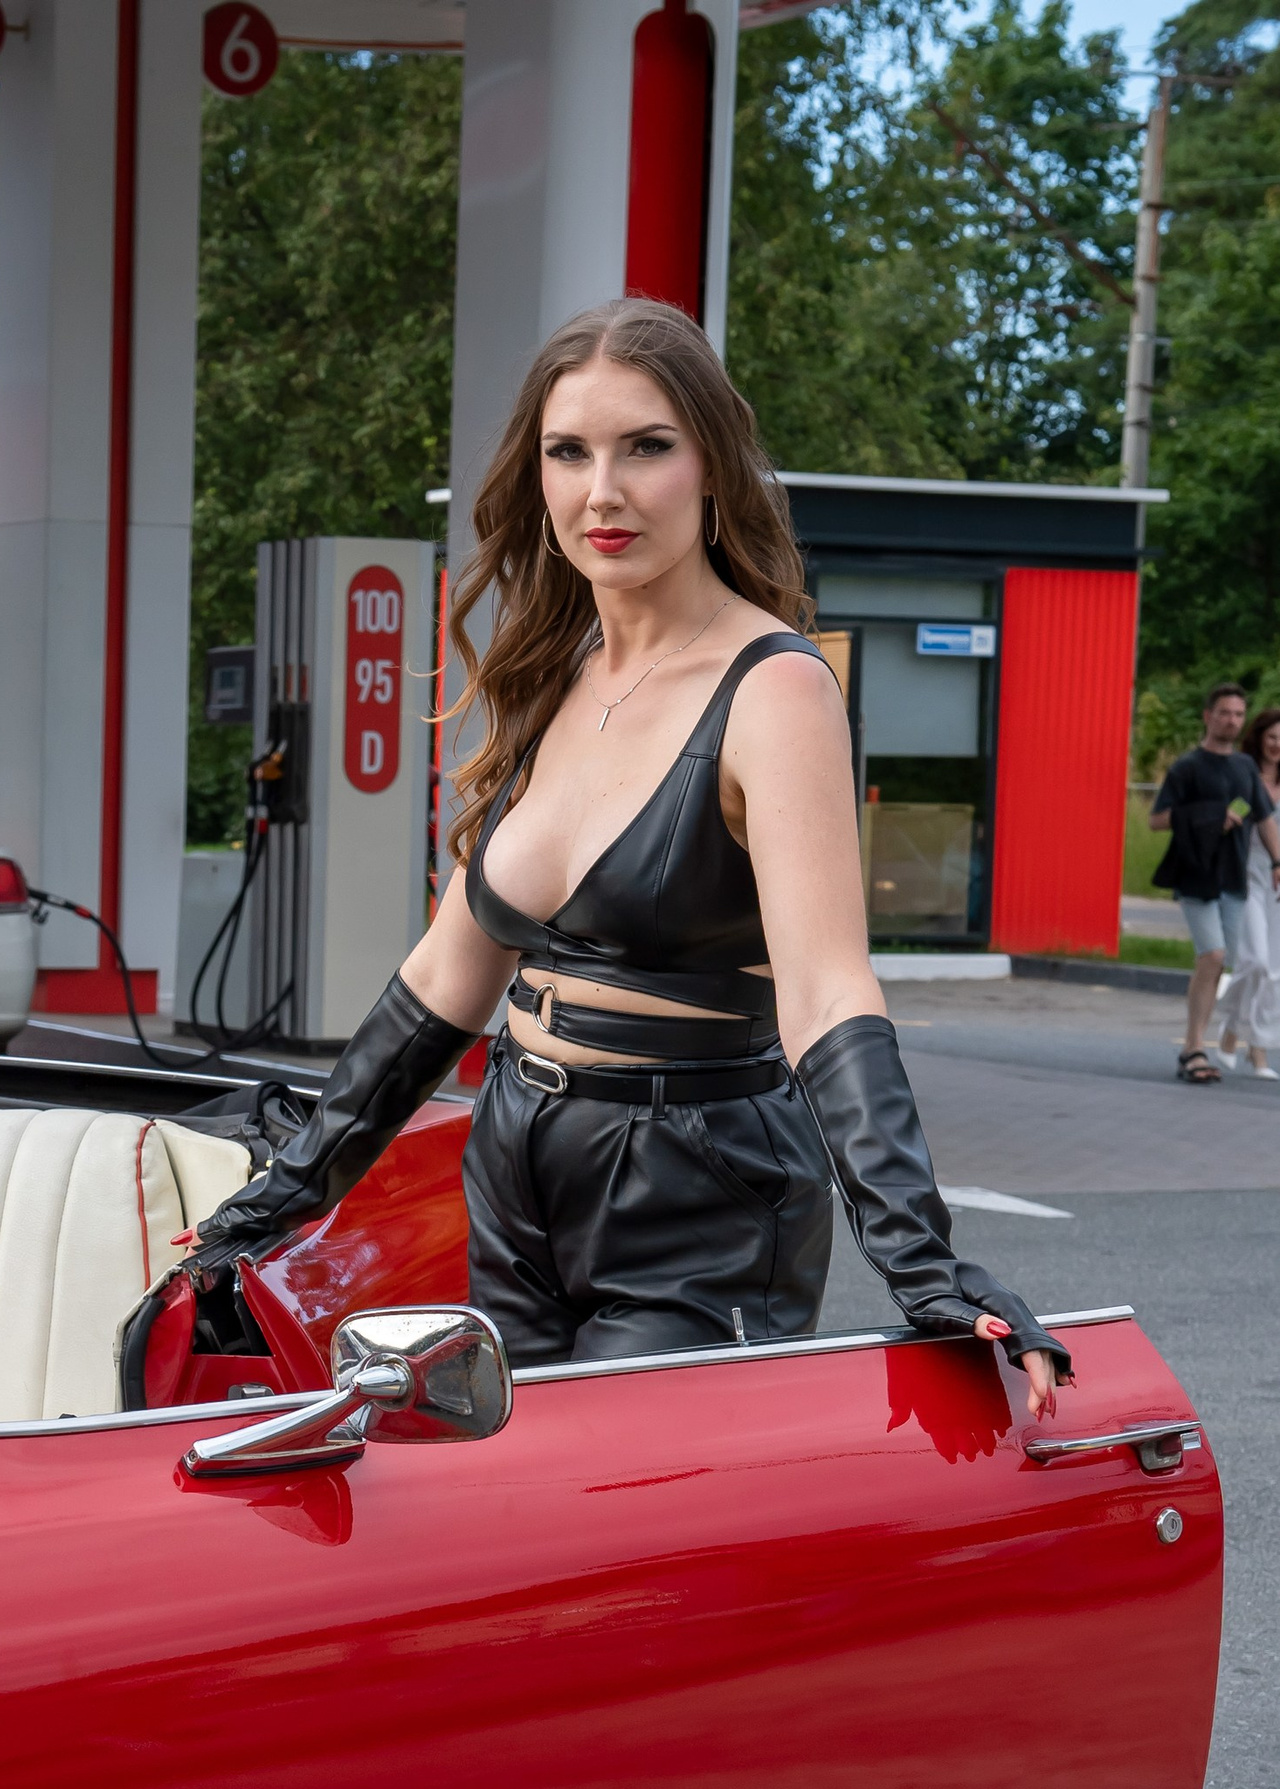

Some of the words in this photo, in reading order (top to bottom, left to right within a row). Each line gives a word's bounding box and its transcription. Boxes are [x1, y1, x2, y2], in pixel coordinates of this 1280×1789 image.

[221, 14, 261, 83] 6
[351, 589, 400, 634] 100
[355, 658, 394, 704] 95
[360, 730, 385, 774] D
